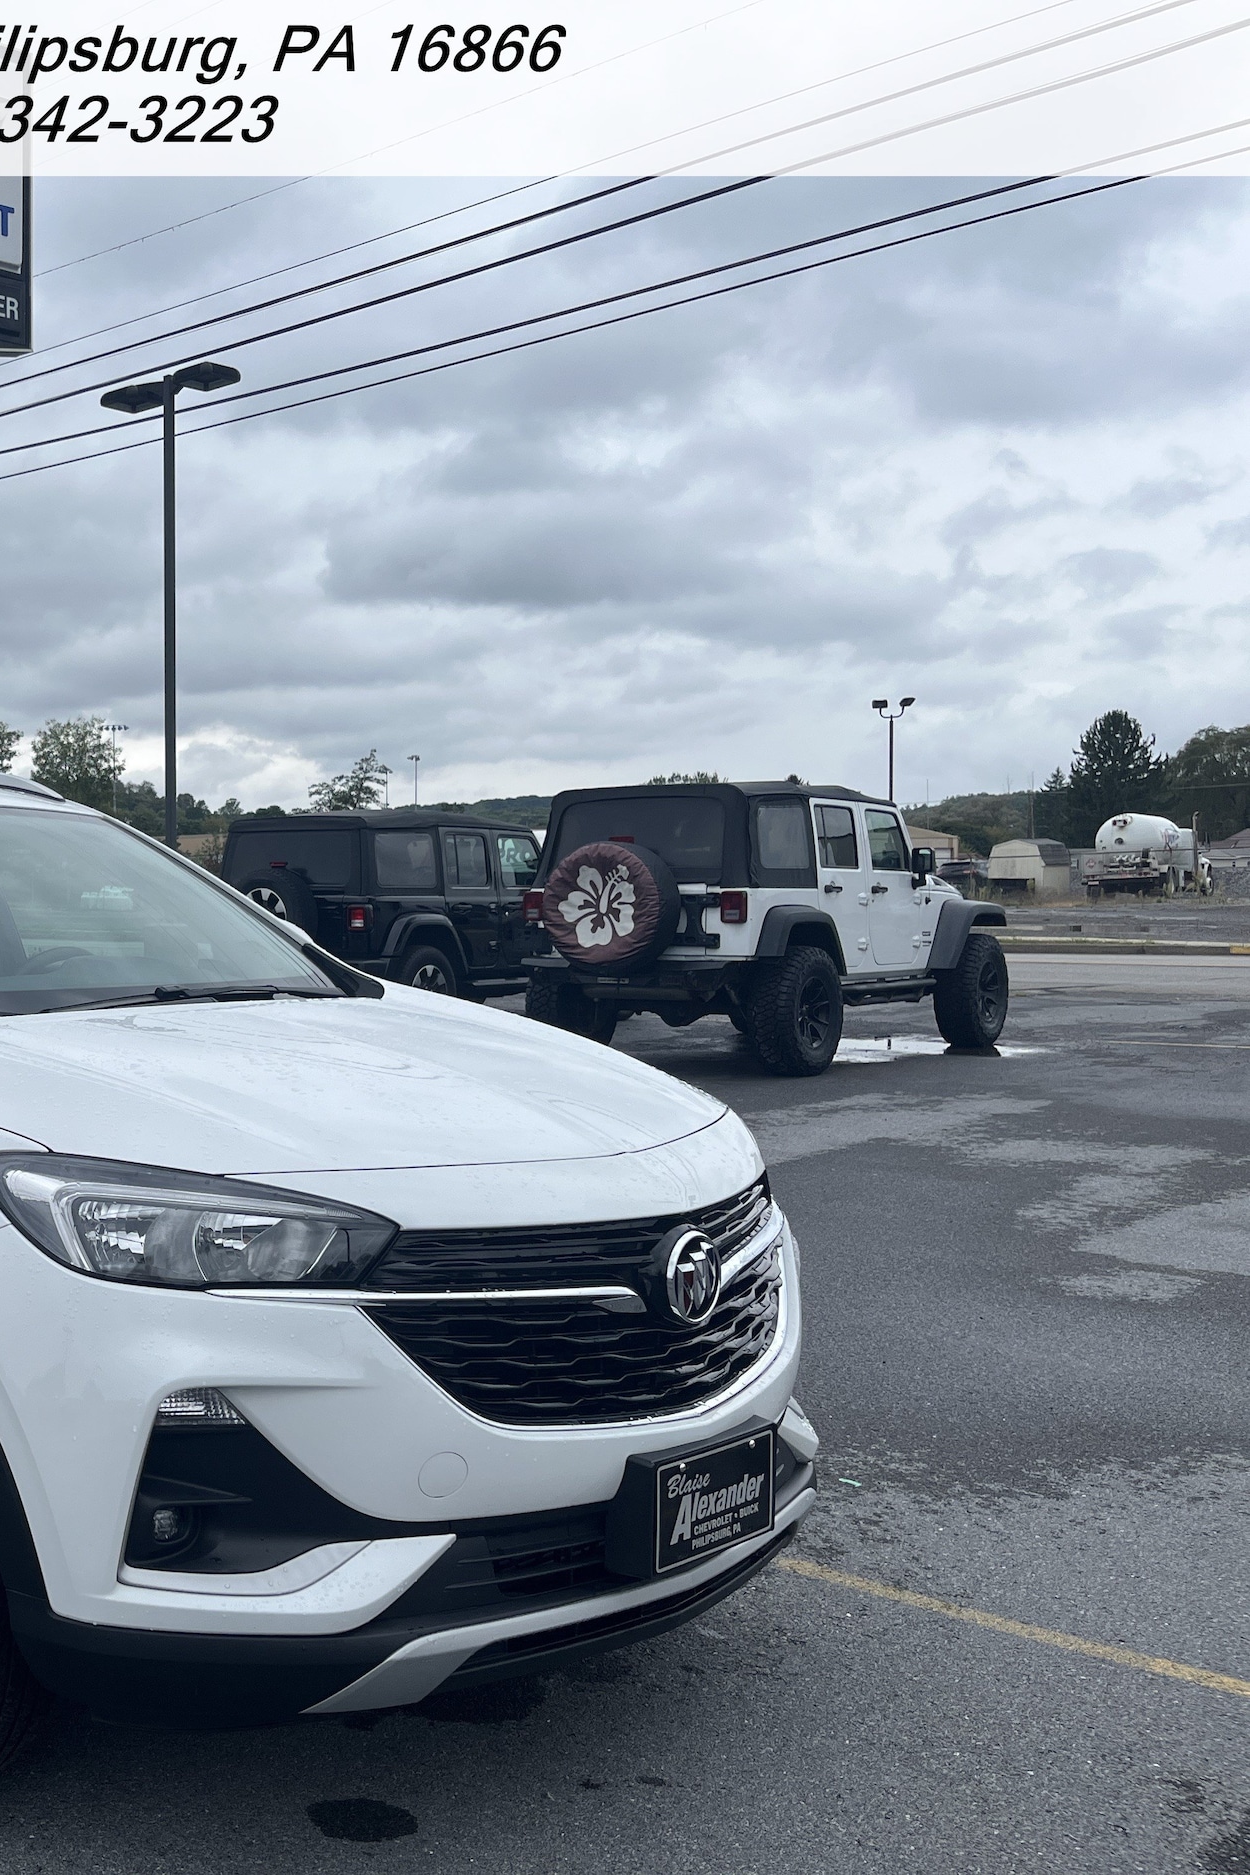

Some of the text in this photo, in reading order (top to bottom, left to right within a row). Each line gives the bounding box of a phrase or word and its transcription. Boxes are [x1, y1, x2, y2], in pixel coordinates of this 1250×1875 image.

[667, 1472, 711, 1499] Blaise
[670, 1473, 765, 1546] Alexander
[694, 1502, 760, 1537] CHEVROLET BUICK
[732, 1522, 742, 1534] PA
